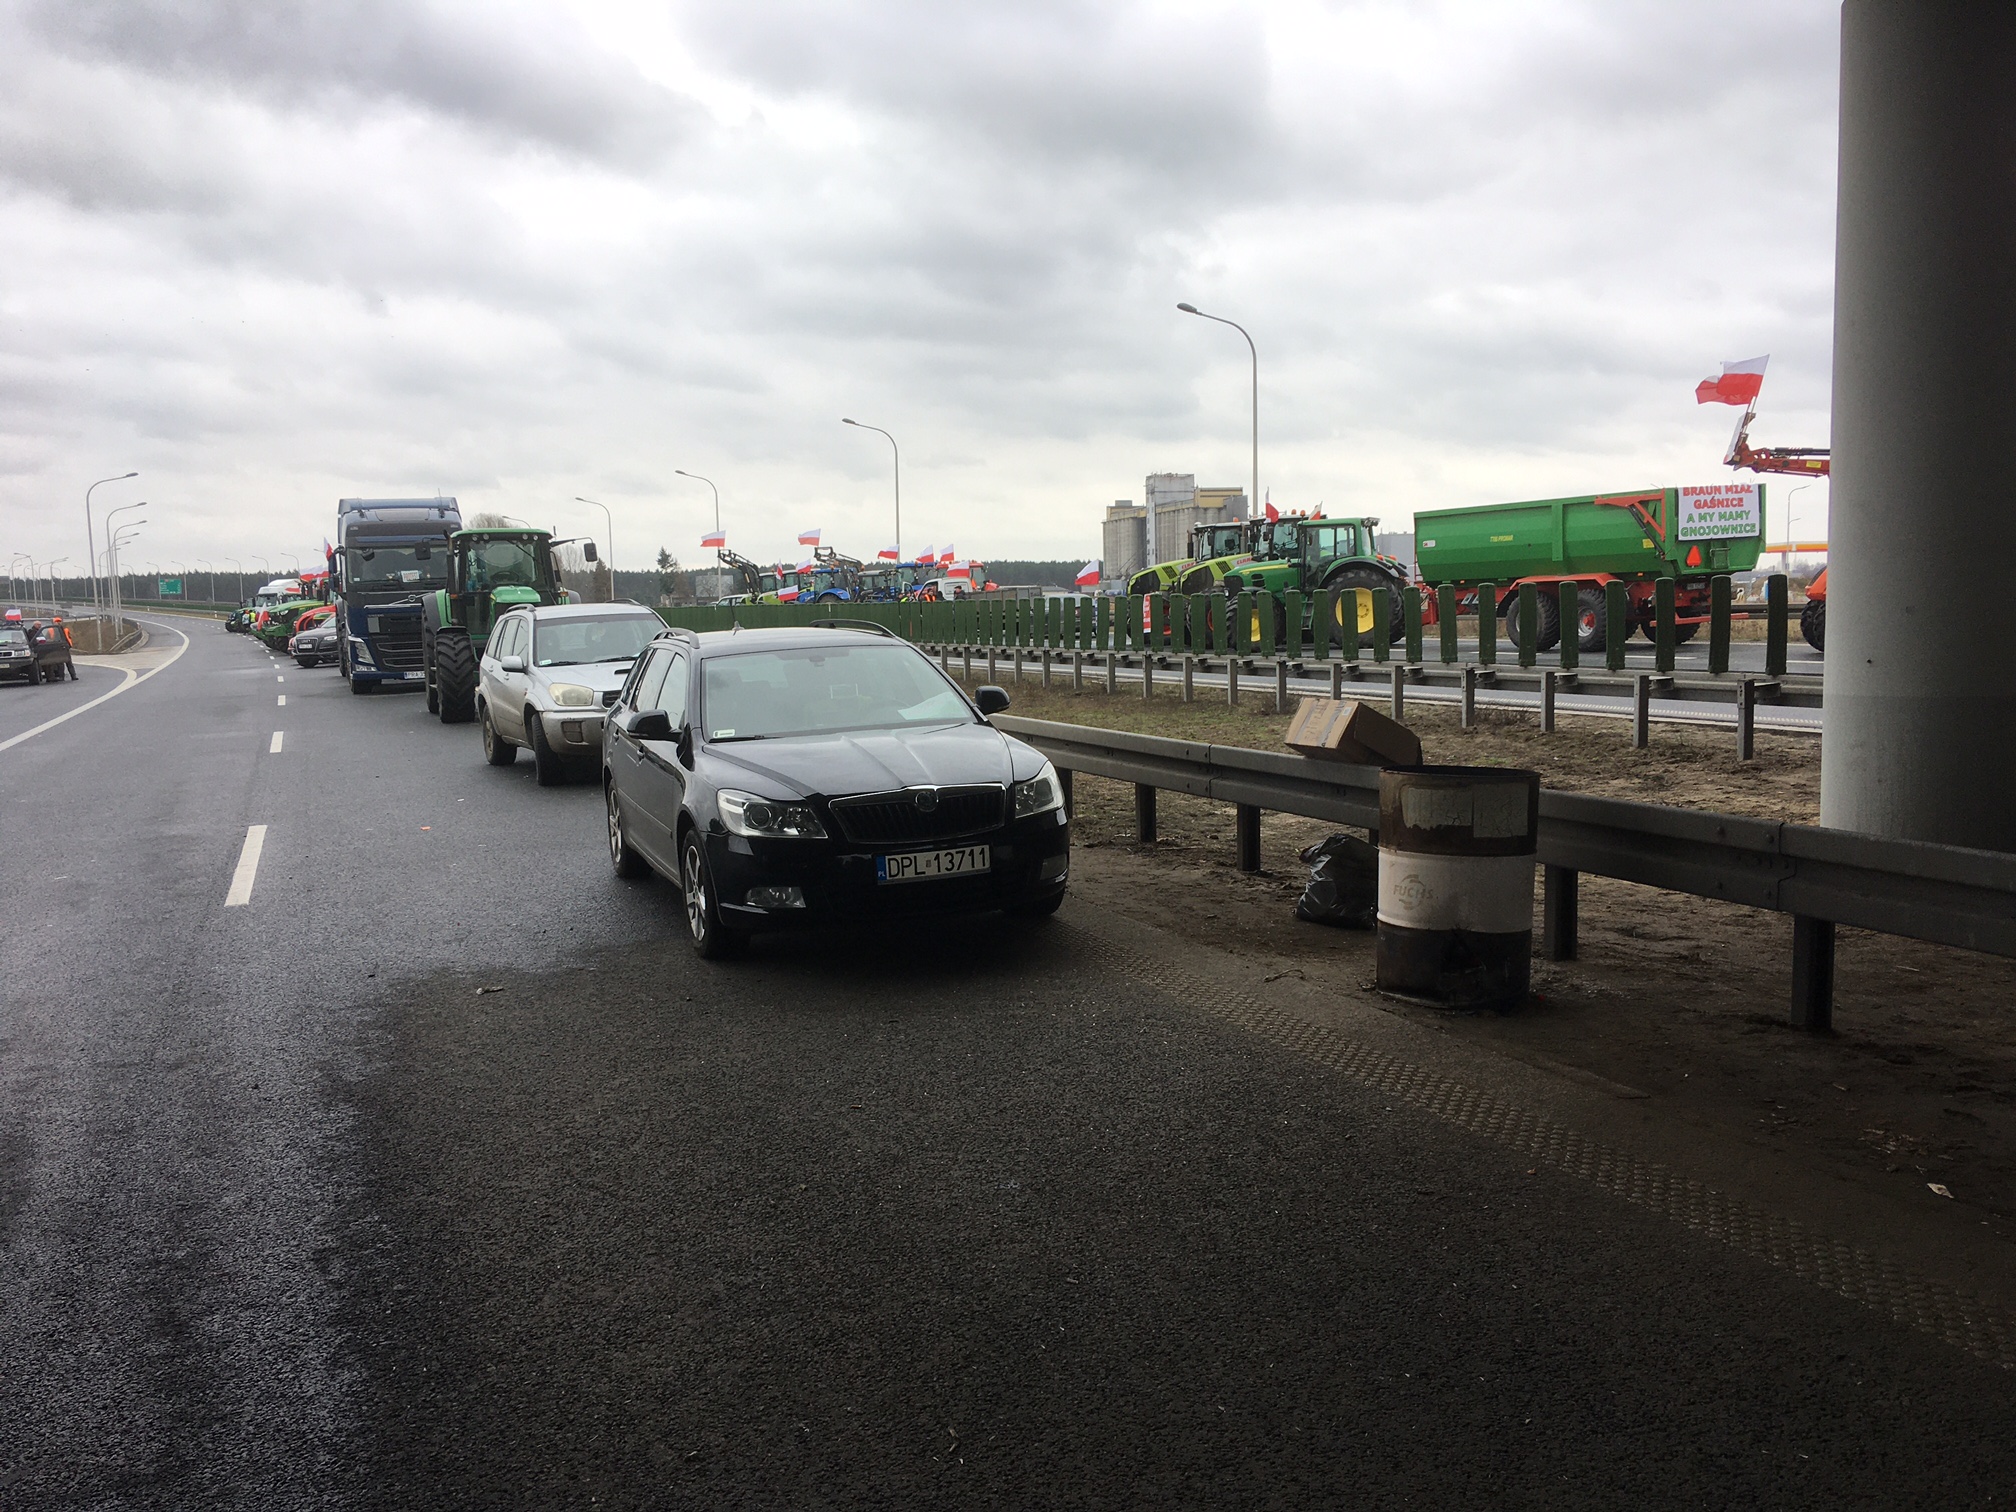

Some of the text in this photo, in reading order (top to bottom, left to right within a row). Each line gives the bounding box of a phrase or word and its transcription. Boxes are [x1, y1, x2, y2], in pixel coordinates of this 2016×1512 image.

[1682, 484, 1753, 496] BRAUN MIAŁ
[1693, 496, 1744, 509] GAŚNICE
[1686, 510, 1751, 523] A MY MAMY
[1680, 523, 1757, 537] GNOJOWNICE
[887, 848, 986, 878] DPL 13711
